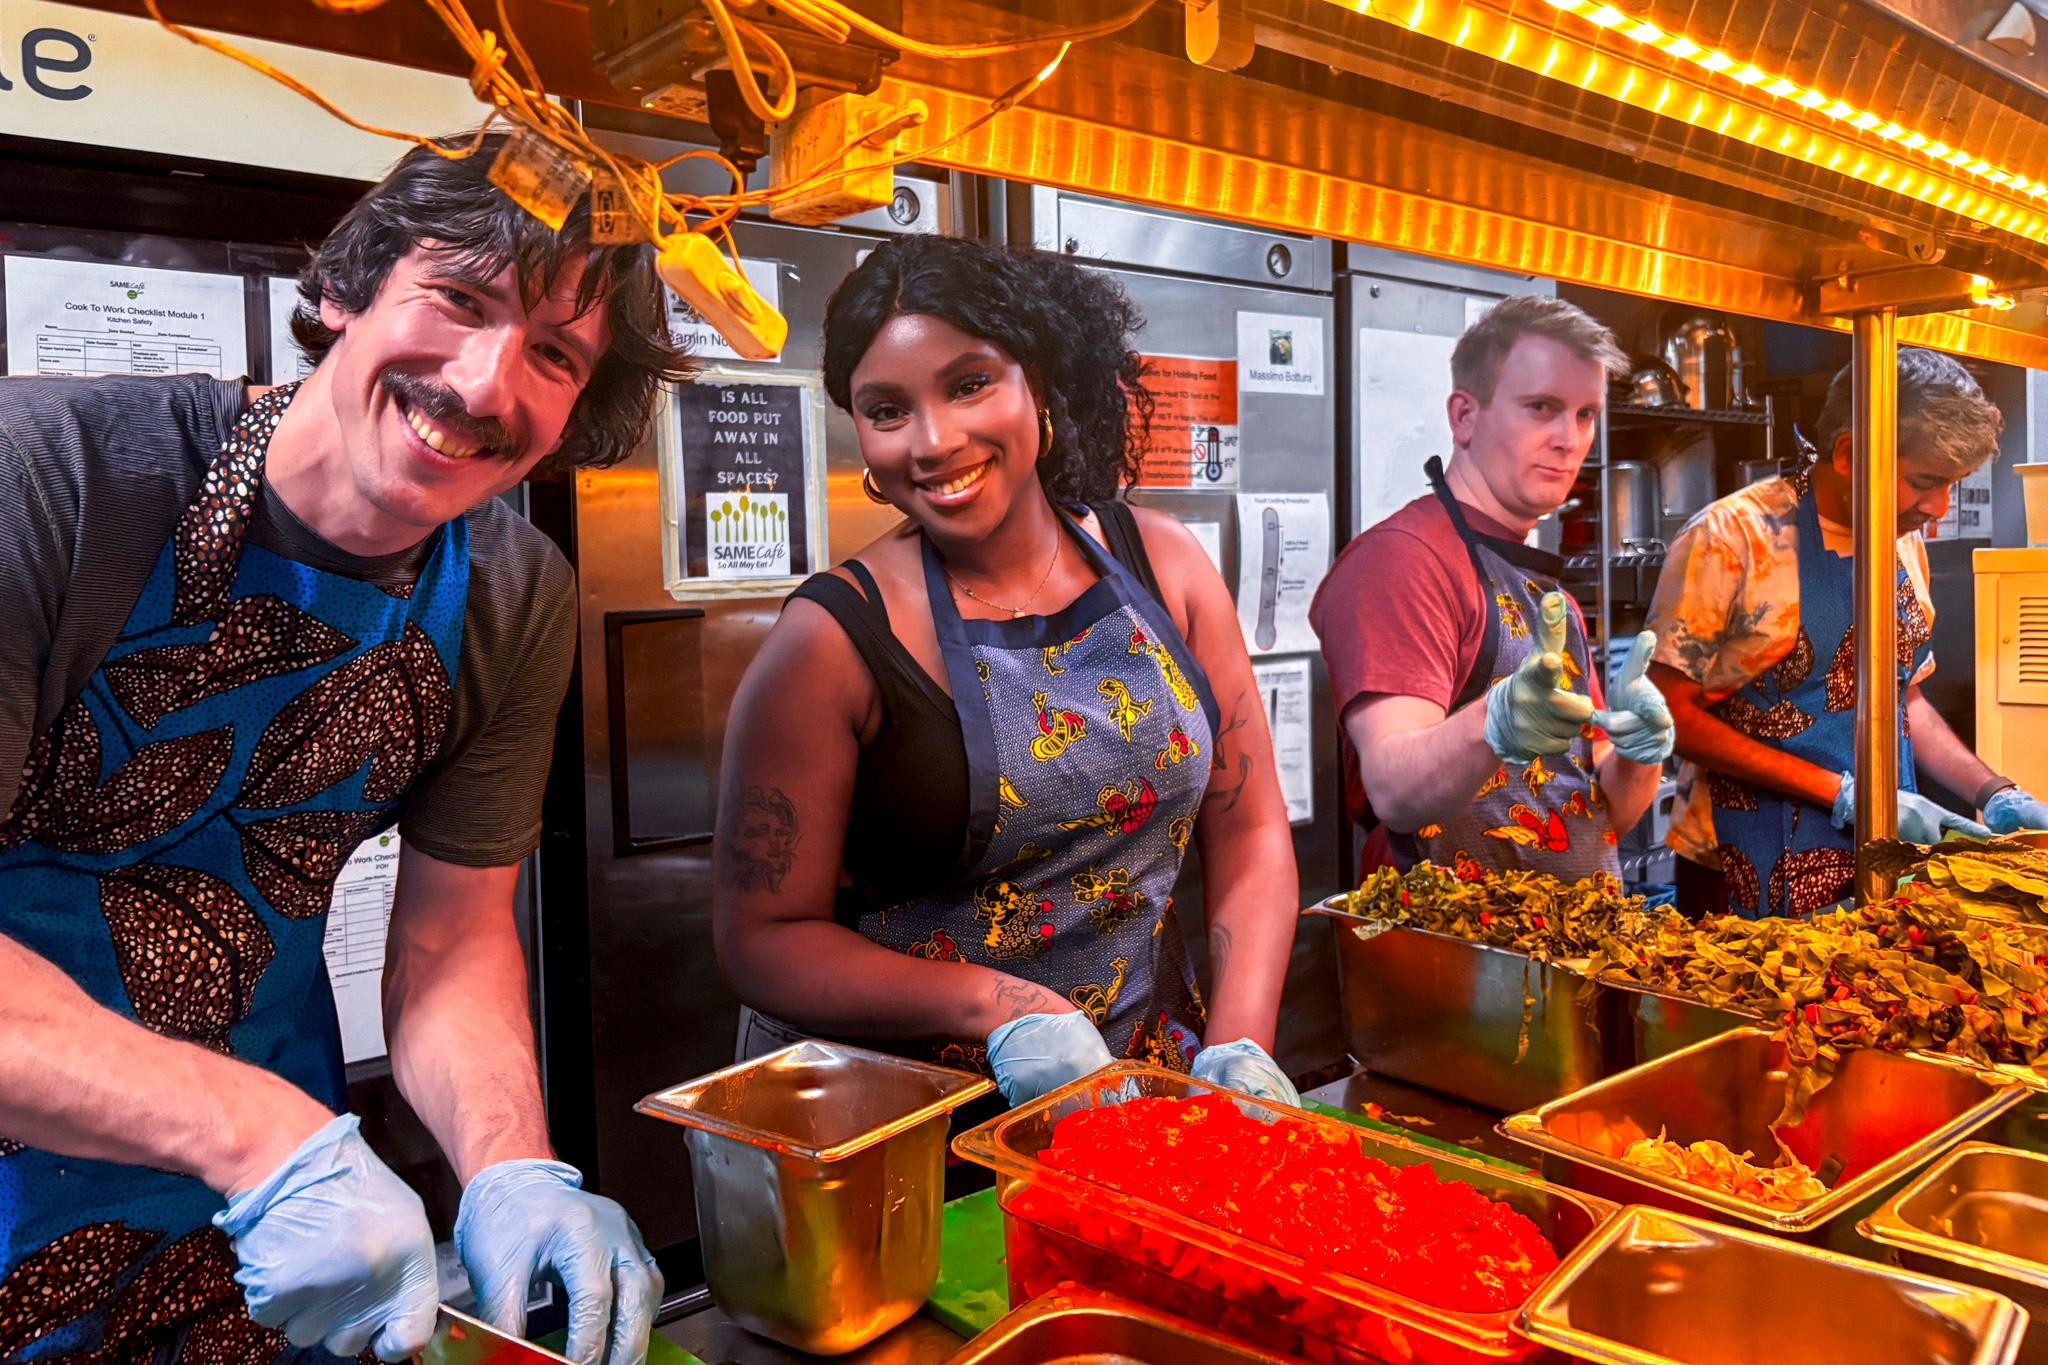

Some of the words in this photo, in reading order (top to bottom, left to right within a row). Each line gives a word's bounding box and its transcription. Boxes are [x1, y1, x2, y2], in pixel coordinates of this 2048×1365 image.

[0, 27, 93, 101] e
[65, 302, 88, 311] Cook
[90, 304, 100, 312] To
[103, 305, 125, 314] Work
[127, 307, 166, 317] Checklist
[168, 310, 198, 319] Module
[106, 316, 131, 325] Kitchen
[133, 318, 153, 327] Safety
[711, 333, 729, 347] No
[1250, 369, 1283, 381] Massimo
[721, 391, 736, 403] IS
[741, 392, 768, 405] ALL
[708, 410, 748, 424] FOOD
[753, 412, 781, 425] PUT
[714, 430, 757, 444] AWAY
[763, 432, 778, 445] IN
[735, 451, 762, 464] ALL
[717, 471, 779, 485] SPACES?
[728, 561, 738, 569] All
[740, 561, 755, 570] May
[756, 561, 768, 569] Eat
[354, 856, 372, 864] Work
